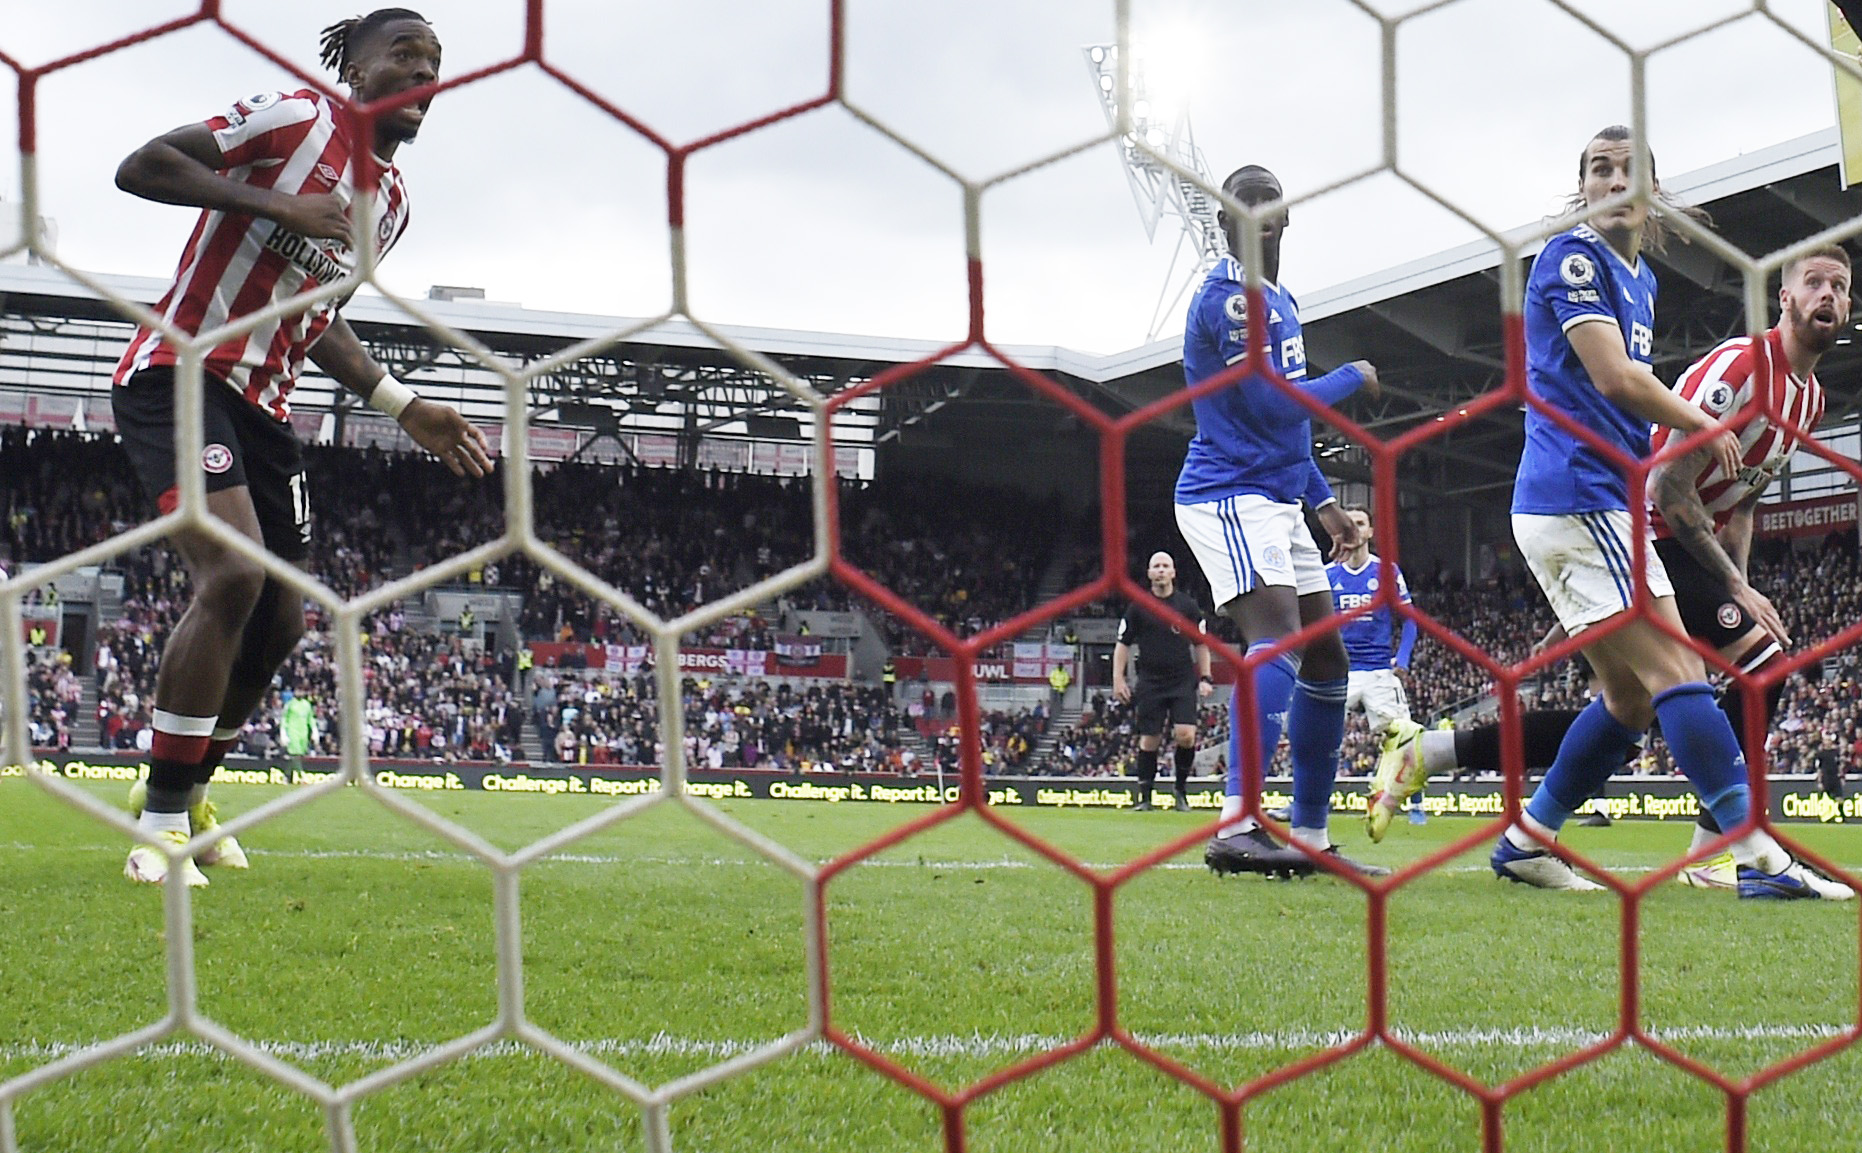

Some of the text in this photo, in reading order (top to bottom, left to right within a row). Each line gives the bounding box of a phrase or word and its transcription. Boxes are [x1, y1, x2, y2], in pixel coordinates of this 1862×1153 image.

[375, 770, 443, 791] Change
[444, 771, 465, 790] it.
[481, 774, 565, 794] Challenge
[567, 775, 587, 792] it.
[590, 778, 647, 796] Report
[682, 781, 733, 800] hange
[734, 780, 752, 797] it.
[850, 783, 868, 800] it.
[871, 785, 925, 803] Report
[1643, 793, 1686, 820] Report
